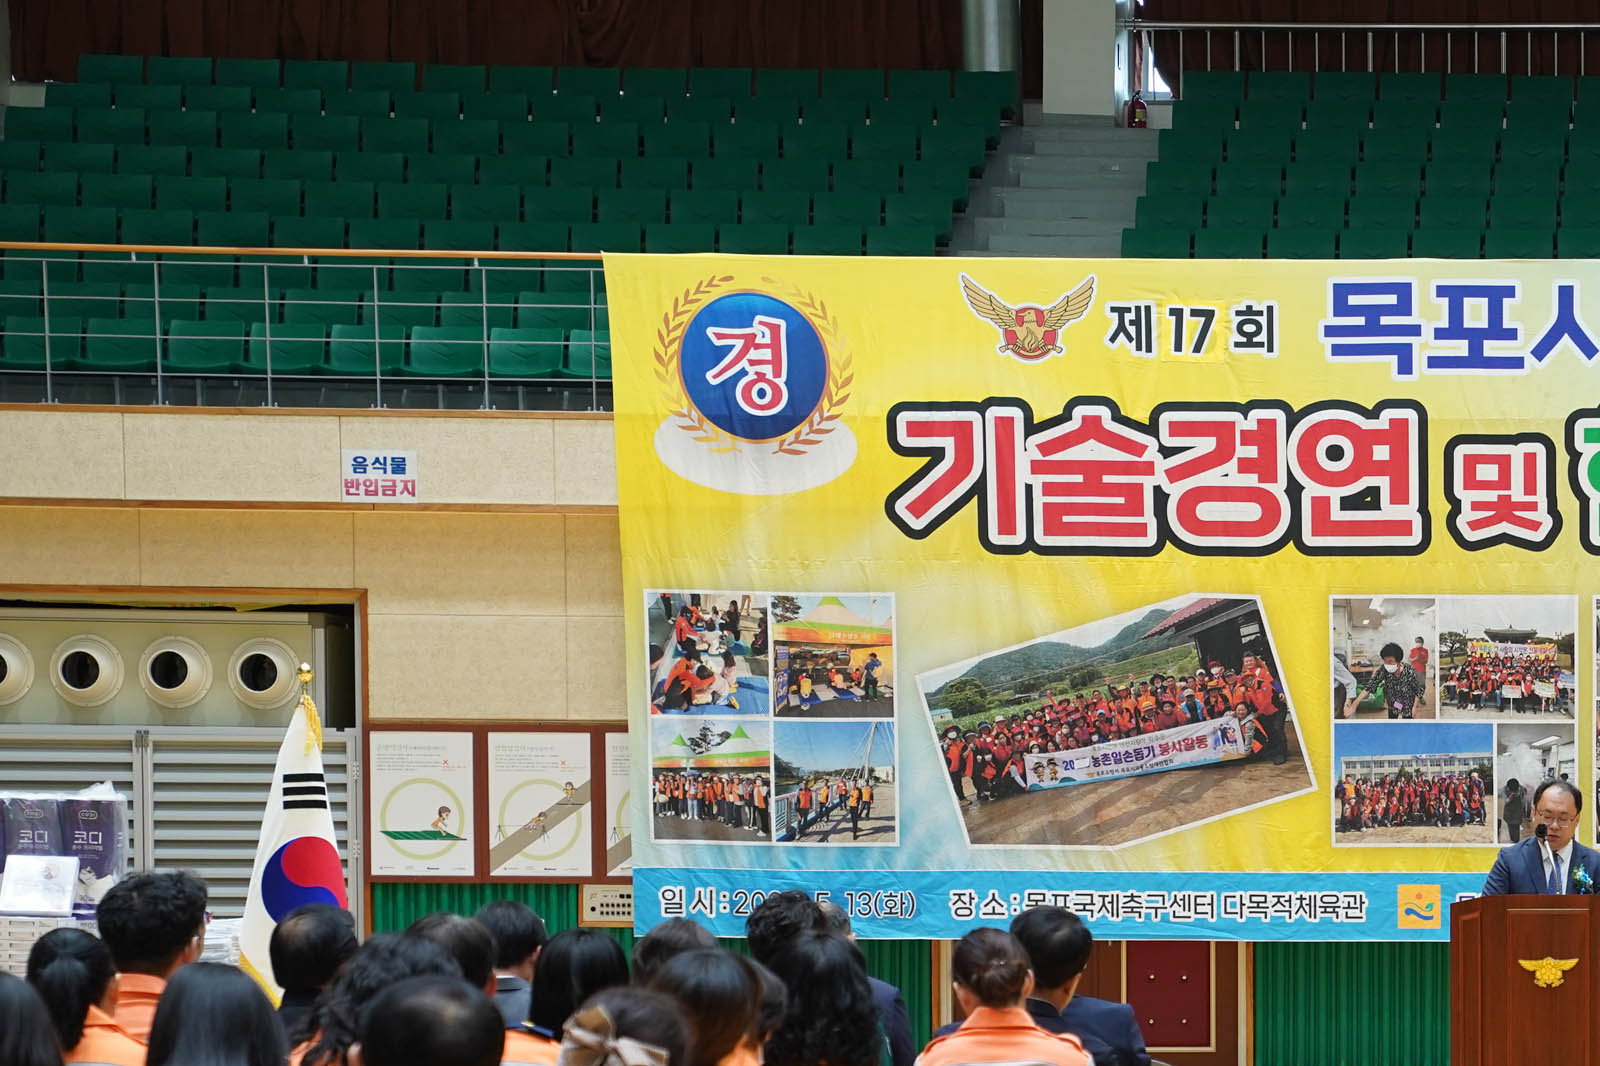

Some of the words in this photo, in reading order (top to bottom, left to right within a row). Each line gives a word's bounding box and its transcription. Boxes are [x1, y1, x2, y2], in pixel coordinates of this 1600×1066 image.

[708, 318, 788, 413] 경
[351, 455, 407, 475] 음식물
[895, 403, 1421, 546] 기술경연
[1455, 444, 1550, 540] 및
[344, 478, 416, 497] 반입금지
[1091, 744, 1157, 769] 농촌일손돕기
[1158, 734, 1210, 757] 봉사활동
[18, 830, 48, 843] 코디
[73, 831, 102, 844] 코디
[846, 889, 916, 917] 13(화)
[1222, 892, 1366, 921] 다목적체육관
